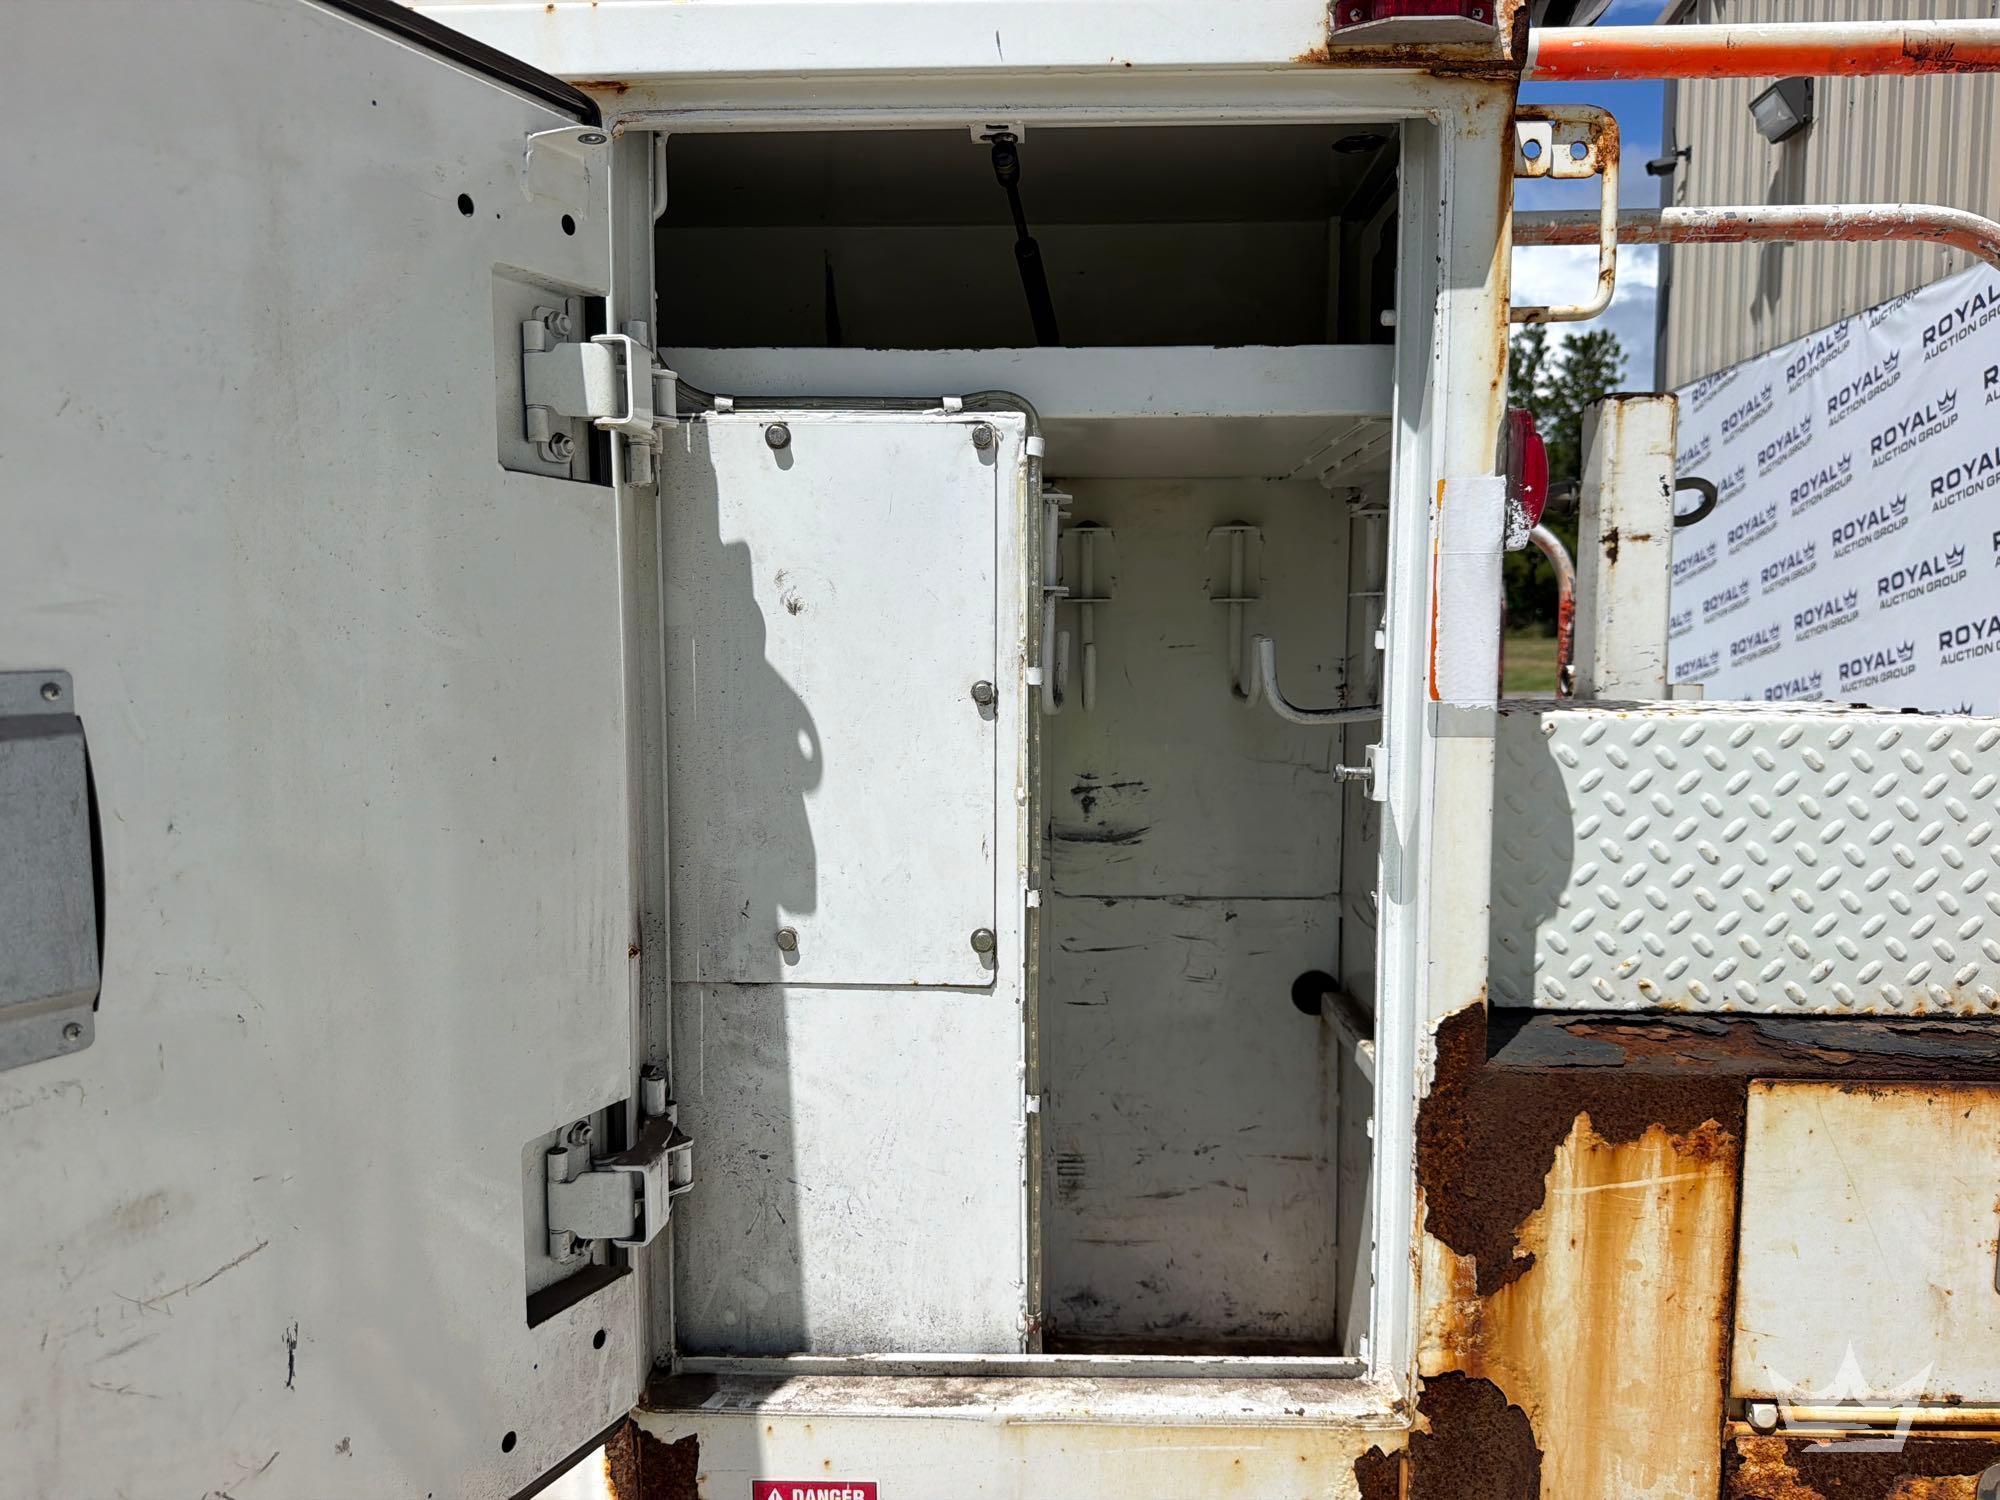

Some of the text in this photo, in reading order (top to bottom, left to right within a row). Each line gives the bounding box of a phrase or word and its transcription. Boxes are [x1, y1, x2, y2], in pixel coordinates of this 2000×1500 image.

[1923, 285, 2000, 348] ROYAL
[1786, 335, 1834, 384] ROYAL
[1820, 339, 1850, 369] GROUP
[1924, 322, 1977, 363] AUCTION
[1827, 366, 1883, 415] ROYAL
[1828, 371, 1901, 428] AUCTION GROUP
[1721, 394, 1761, 436] ROYAL
[1870, 404, 1937, 456] ROYAL
[1757, 425, 1800, 467] ROYAL
[1872, 412, 1959, 470] AUCTION GROUP
[1790, 464, 1838, 507] ROYAL
[1823, 472, 1853, 498] GROUP
[1932, 479, 1985, 514] AUCTION
[1727, 511, 1766, 545] ROYAL
[1832, 505, 1890, 547] ROYAL
[1833, 516, 1909, 560] AUCTION GROUP
[1761, 551, 1803, 585] ROYAL
[1877, 555, 1945, 598] ROYAL
[1702, 586, 1739, 614] ROYAL
[1879, 569, 1967, 610] AUCTION GROUP
[1793, 597, 1843, 631] ROYAL
[1938, 614, 2000, 651] ROYA
[1730, 629, 1770, 657] ROYAL
[1940, 641, 1993, 667] AUCTION
[1839, 648, 1896, 681] ROYAL
[1840, 663, 1916, 694] AUCTION GROUP
[1764, 676, 1809, 702] ROYAL
[792, 1488, 865, 1500] DANGER
